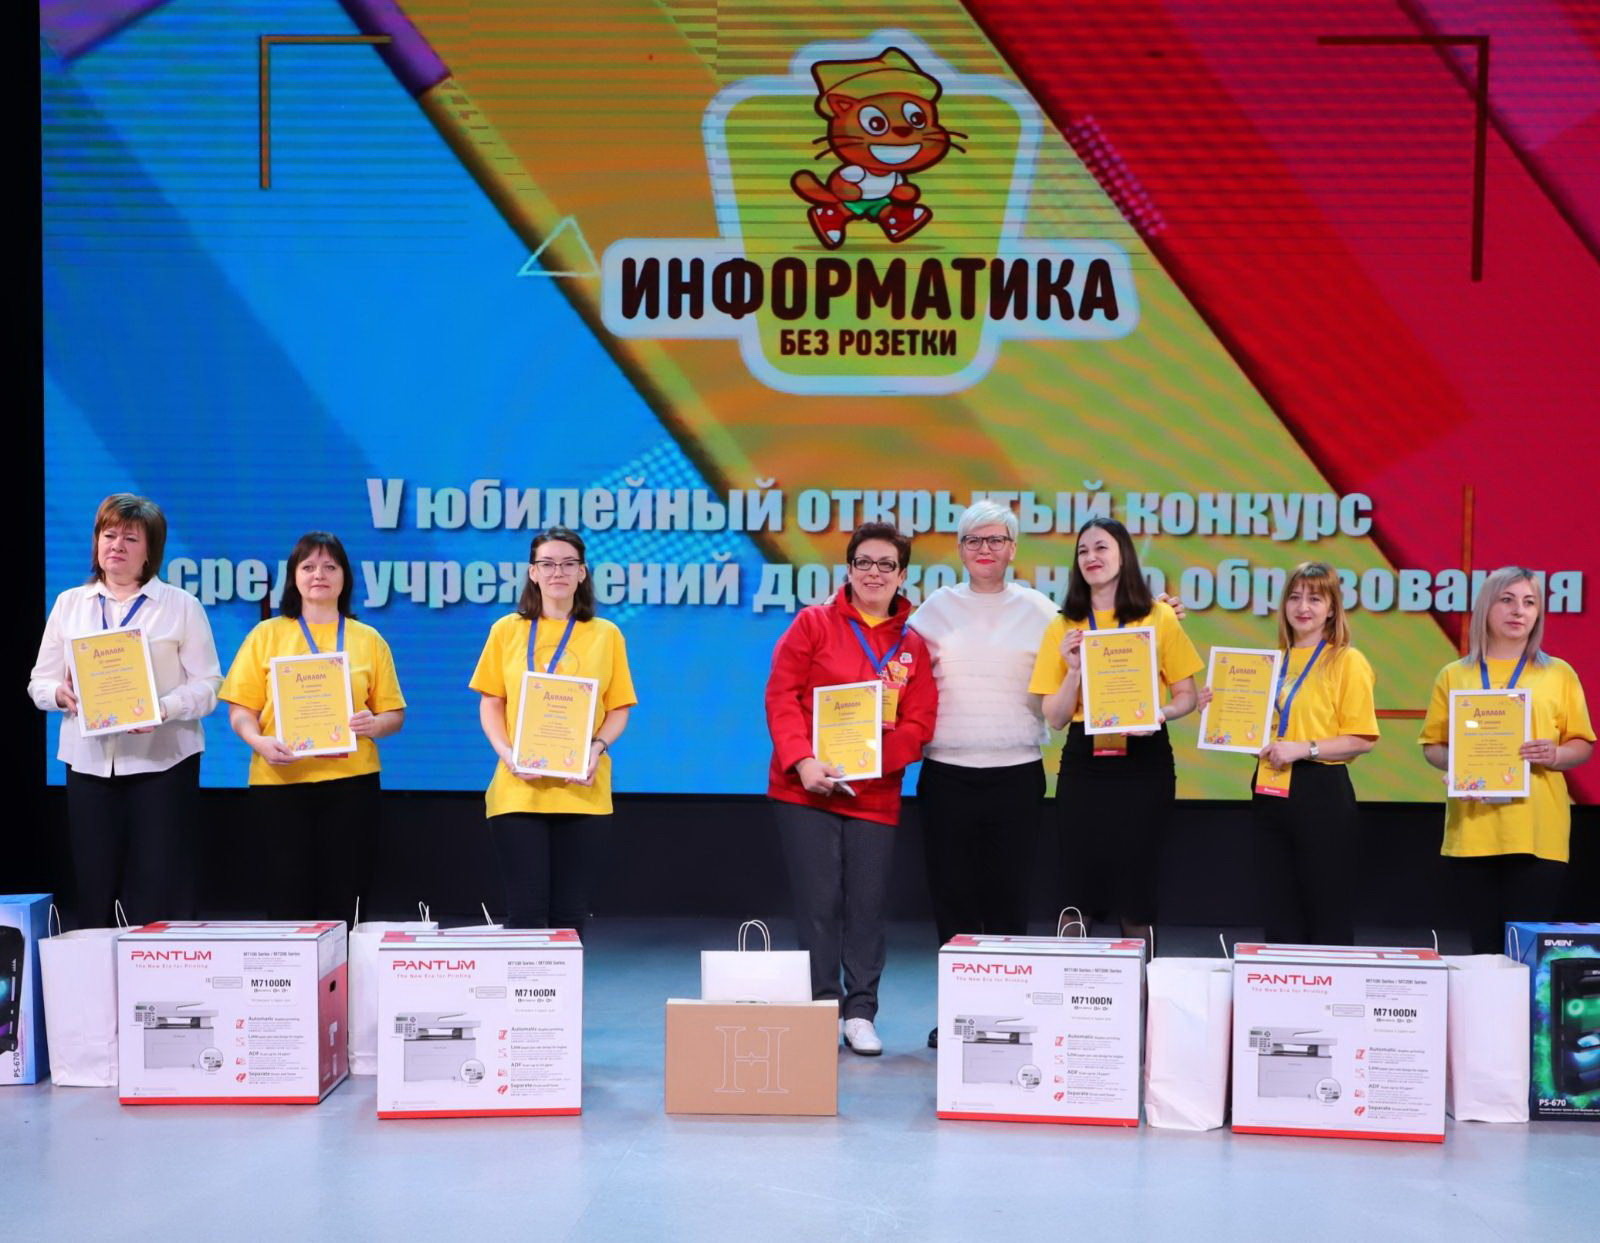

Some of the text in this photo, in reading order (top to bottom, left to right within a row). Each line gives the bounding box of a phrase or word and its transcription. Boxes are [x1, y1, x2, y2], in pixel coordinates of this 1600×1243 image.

[621, 257, 1120, 321] ИНФОРМАТИКА
[780, 329, 957, 356] БЕЗ РОЗЕТКИ
[366, 478, 404, 529] V
[416, 477, 783, 531] юбилейный
[1125, 491, 1373, 541] конкурс
[361, 551, 740, 608] учрежений
[296, 673, 327, 683] Диплом
[543, 691, 573, 702] Диплом
[1474, 708, 1506, 718] Диплом
[1544, 939, 1572, 947] SVEN
[131, 951, 212, 960] PANTUM
[392, 960, 476, 970] PANTUM
[952, 962, 1032, 975] PANTUM
[251, 979, 291, 987] M7100DN
[1248, 973, 1332, 986] PANTUM
[515, 989, 556, 997] M7100DN
[1071, 996, 1112, 1005] M7100DN
[1374, 1008, 1417, 1018] M7100DN
[714, 1025, 790, 1093] H
[1539, 1099, 1567, 1107] PS-670
